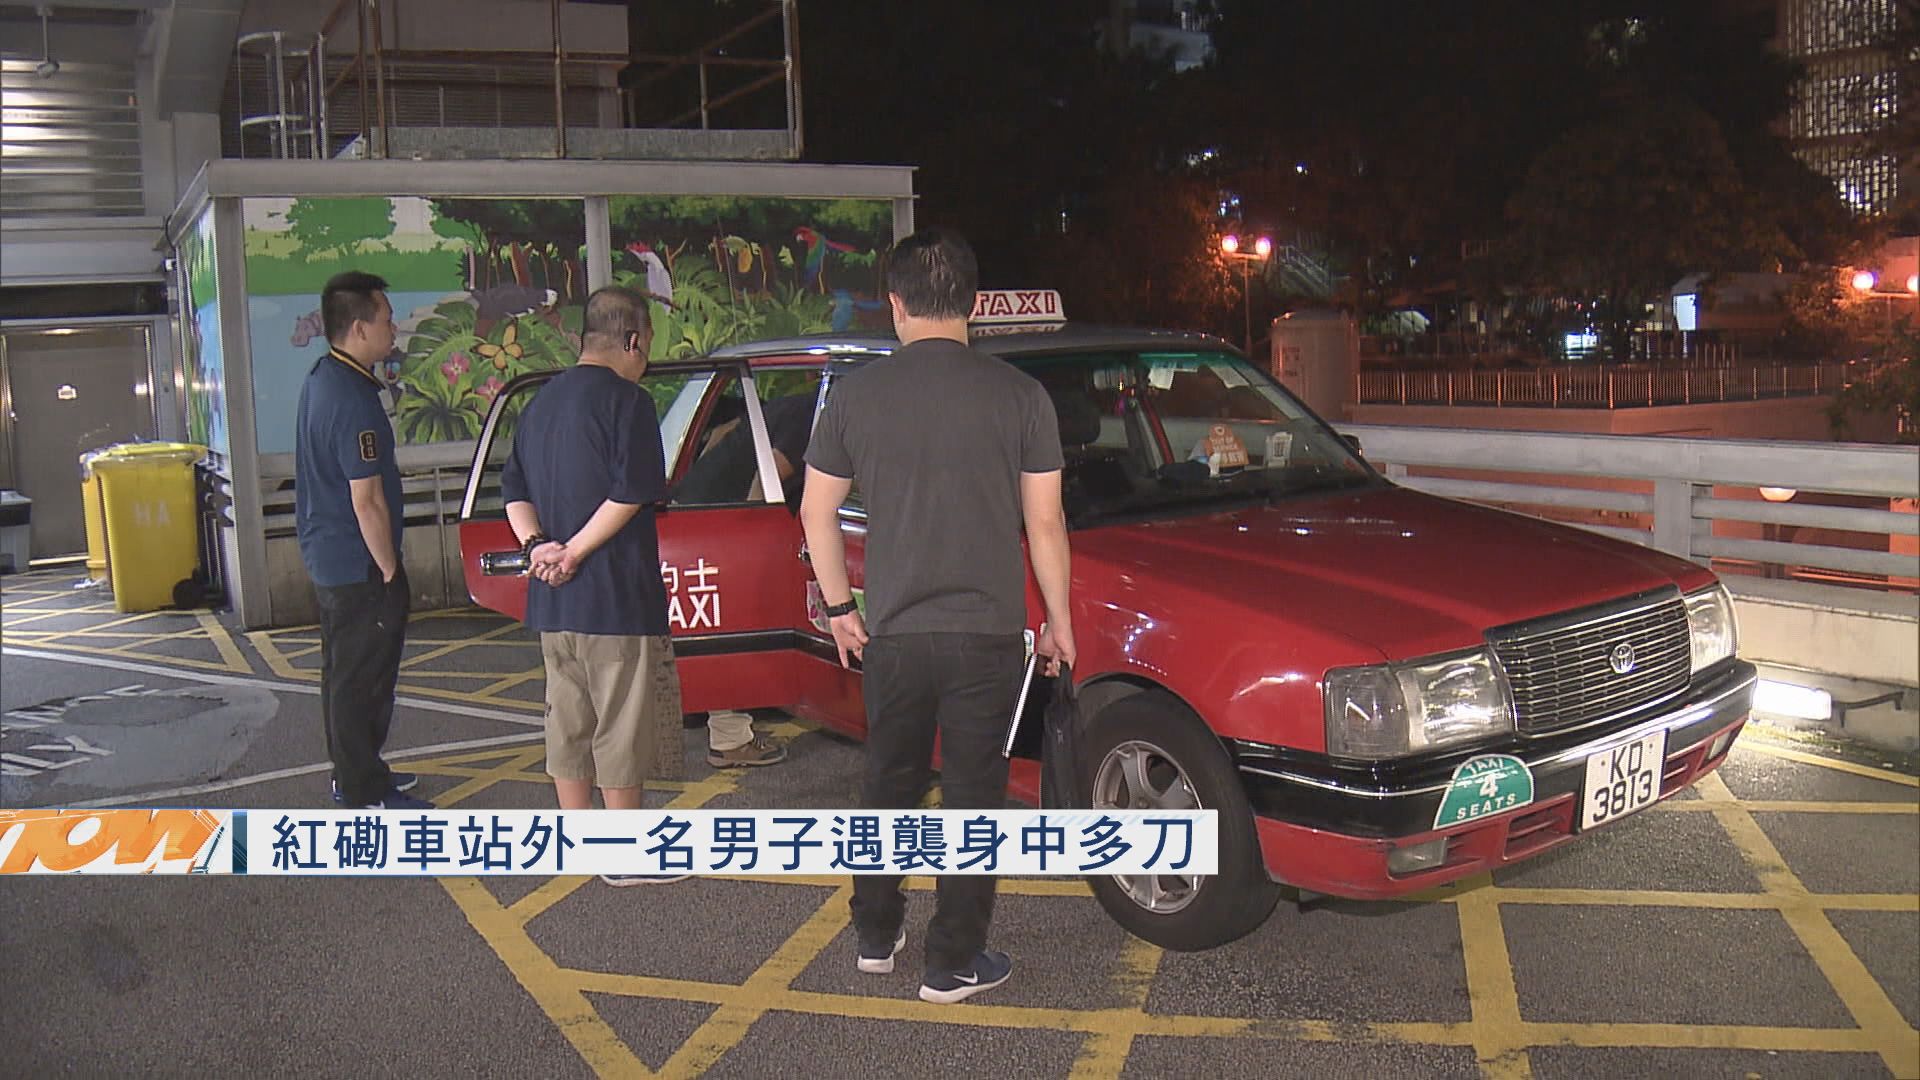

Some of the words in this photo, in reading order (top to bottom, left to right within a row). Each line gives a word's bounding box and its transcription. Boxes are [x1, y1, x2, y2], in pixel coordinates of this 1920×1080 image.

[667, 593, 720, 629] AXI
[1465, 758, 1504, 775] TAXI
[1608, 741, 1643, 785] KD
[1479, 773, 1499, 798] 4
[1592, 769, 1652, 823] 3813
[1456, 793, 1517, 820] SEATS
